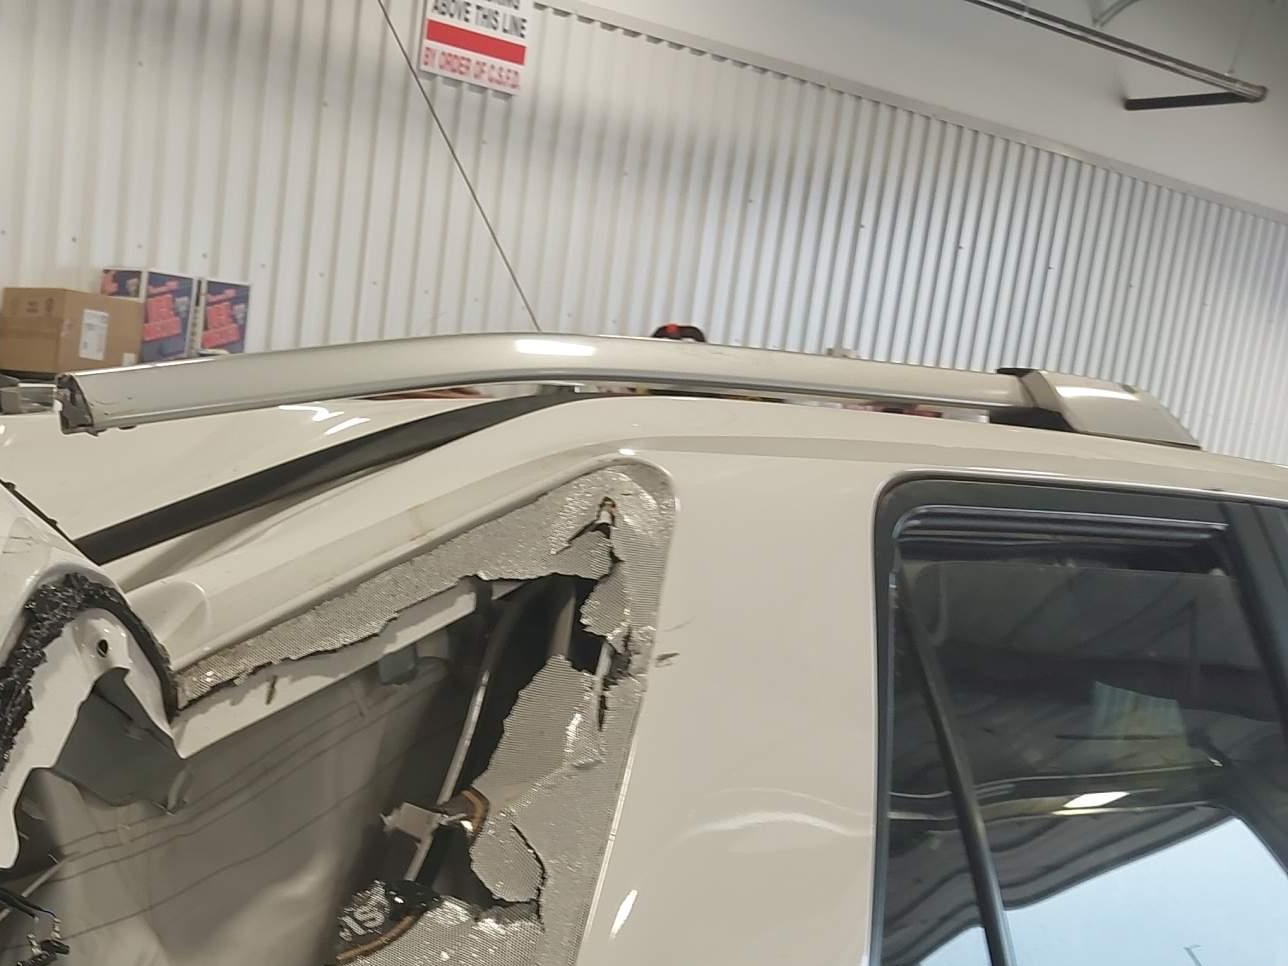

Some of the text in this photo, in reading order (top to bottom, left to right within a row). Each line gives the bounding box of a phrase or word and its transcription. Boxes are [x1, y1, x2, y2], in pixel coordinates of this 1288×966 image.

[432, 0, 527, 39] ABOVE THIS LINE
[423, 47, 437, 67] BY
[439, 51, 472, 76] ORDER
[473, 60, 487, 80] OF
